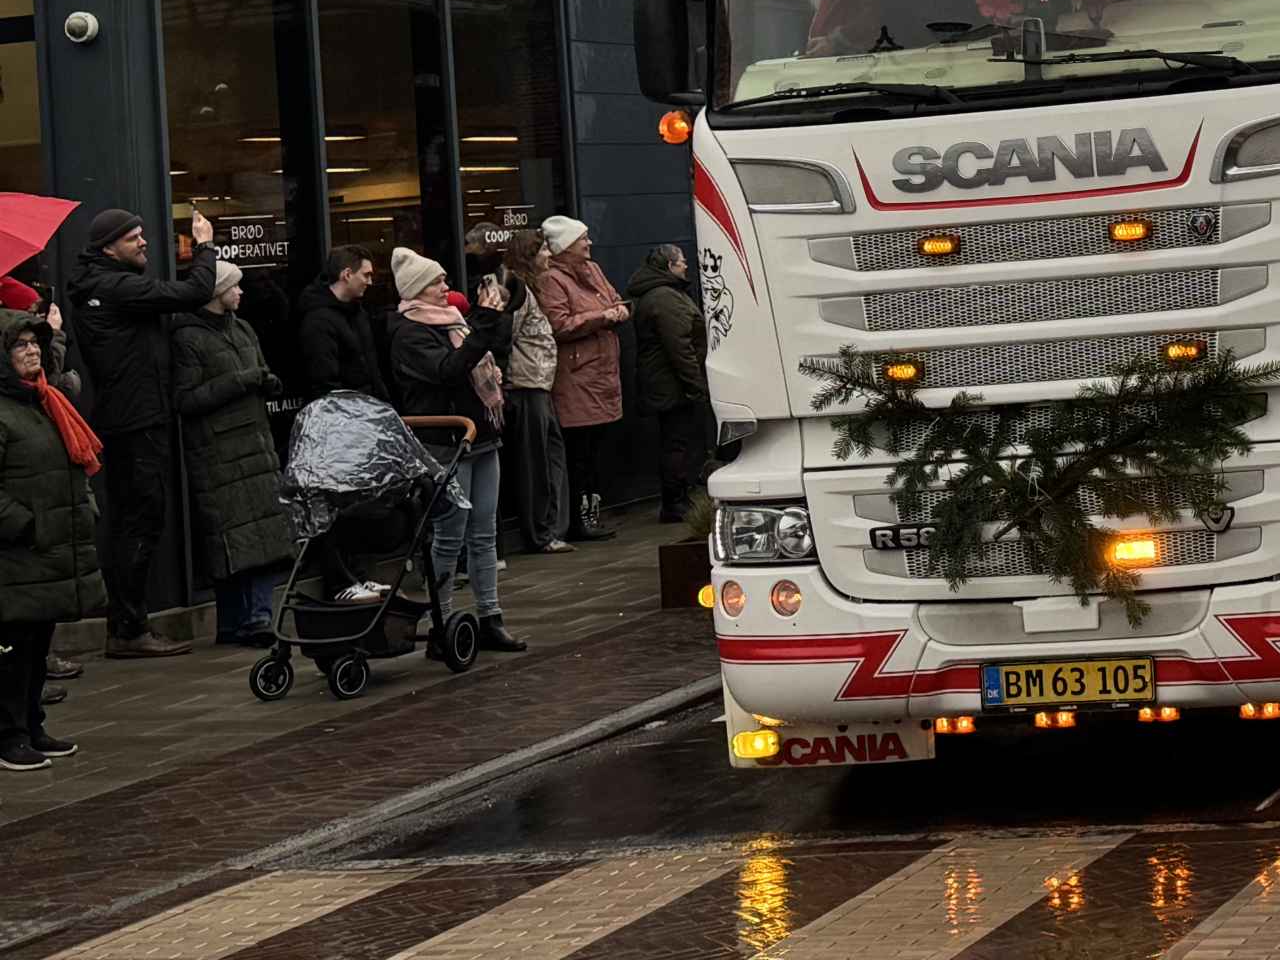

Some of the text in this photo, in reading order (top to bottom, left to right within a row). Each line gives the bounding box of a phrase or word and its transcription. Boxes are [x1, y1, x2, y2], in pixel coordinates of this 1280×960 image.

[891, 127, 1169, 194] SCANIA
[231, 224, 264, 240] BRØD
[214, 242, 289, 259] OOPERATIVET
[1004, 664, 1148, 699] BM 63 105
